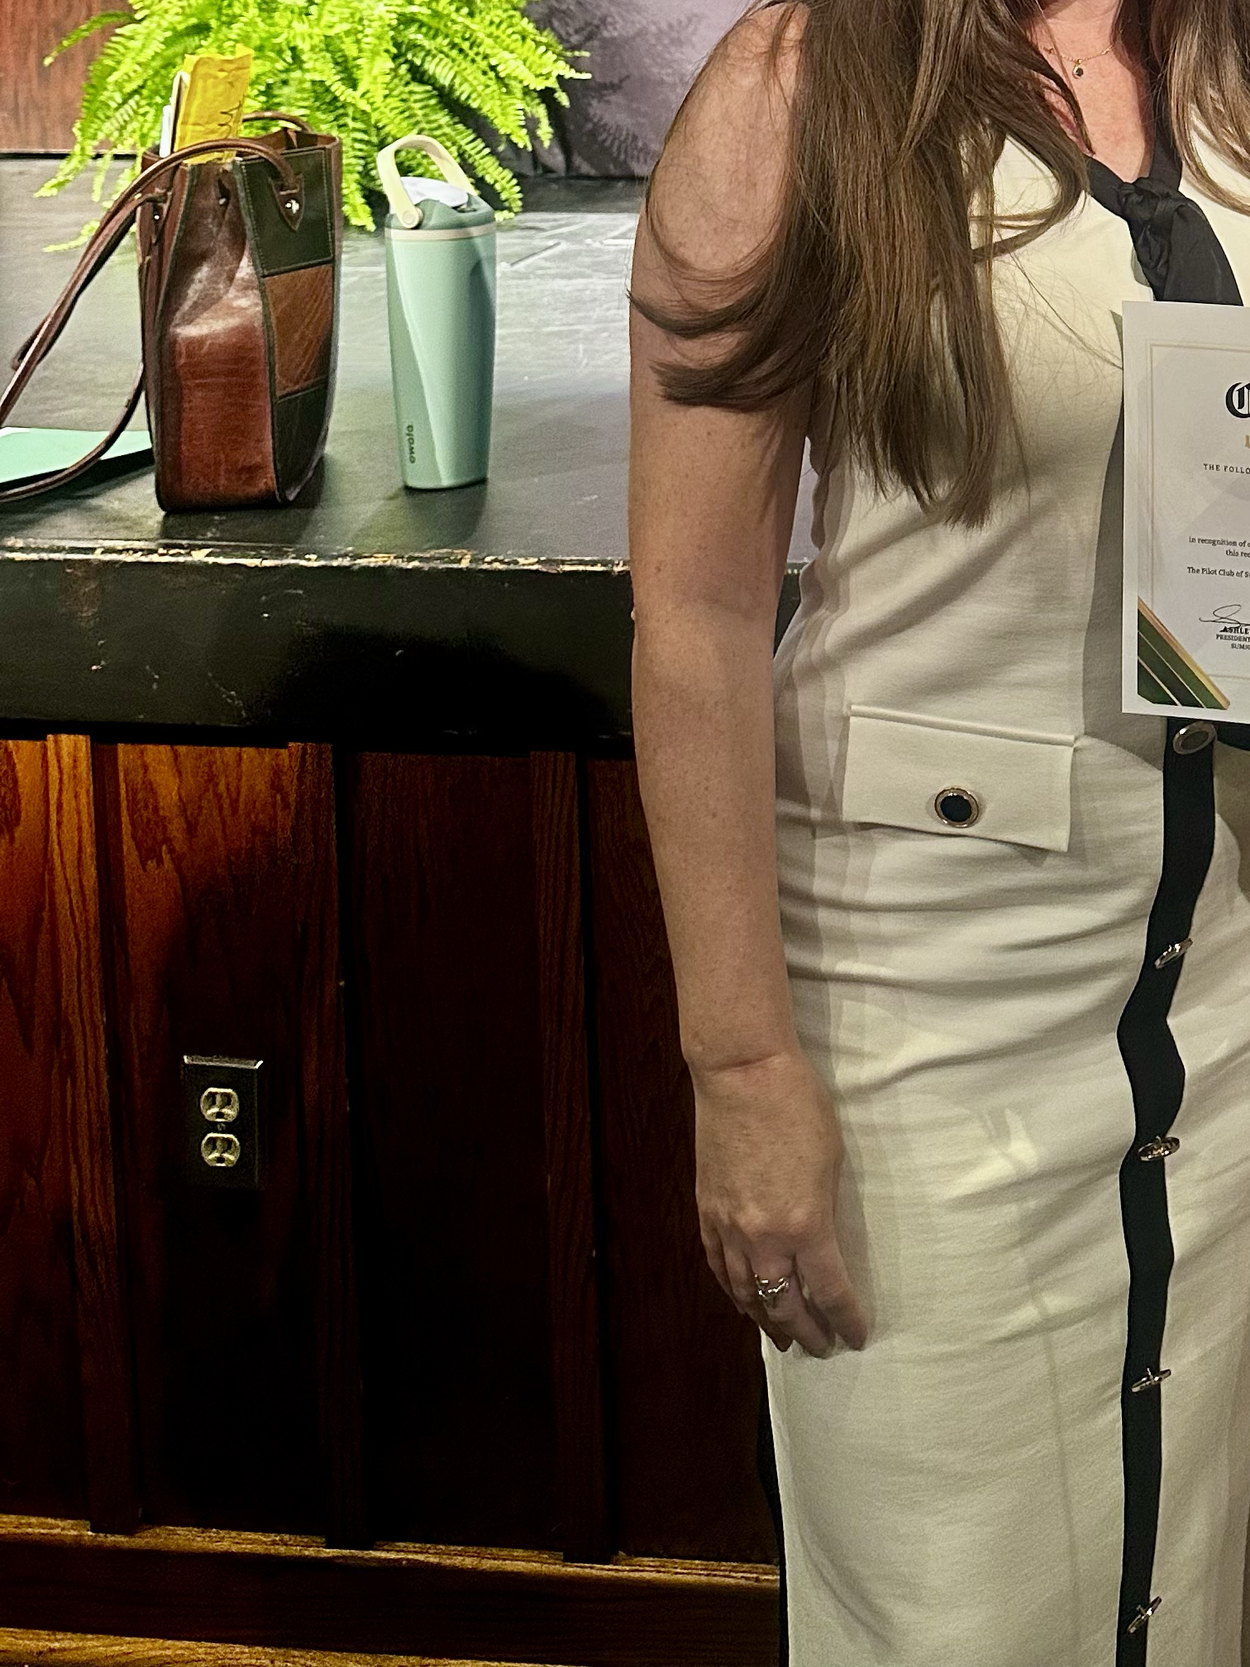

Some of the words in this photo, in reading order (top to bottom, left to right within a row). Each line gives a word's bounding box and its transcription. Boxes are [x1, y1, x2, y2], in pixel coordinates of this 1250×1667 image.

[406, 424, 416, 464] owala
[1203, 463, 1220, 471] THE
[1198, 537, 1237, 546] recognition
[1226, 549, 1239, 557] this
[1187, 566, 1200, 575] The
[1201, 568, 1217, 576] Pilot
[1218, 569, 1234, 577] Club
